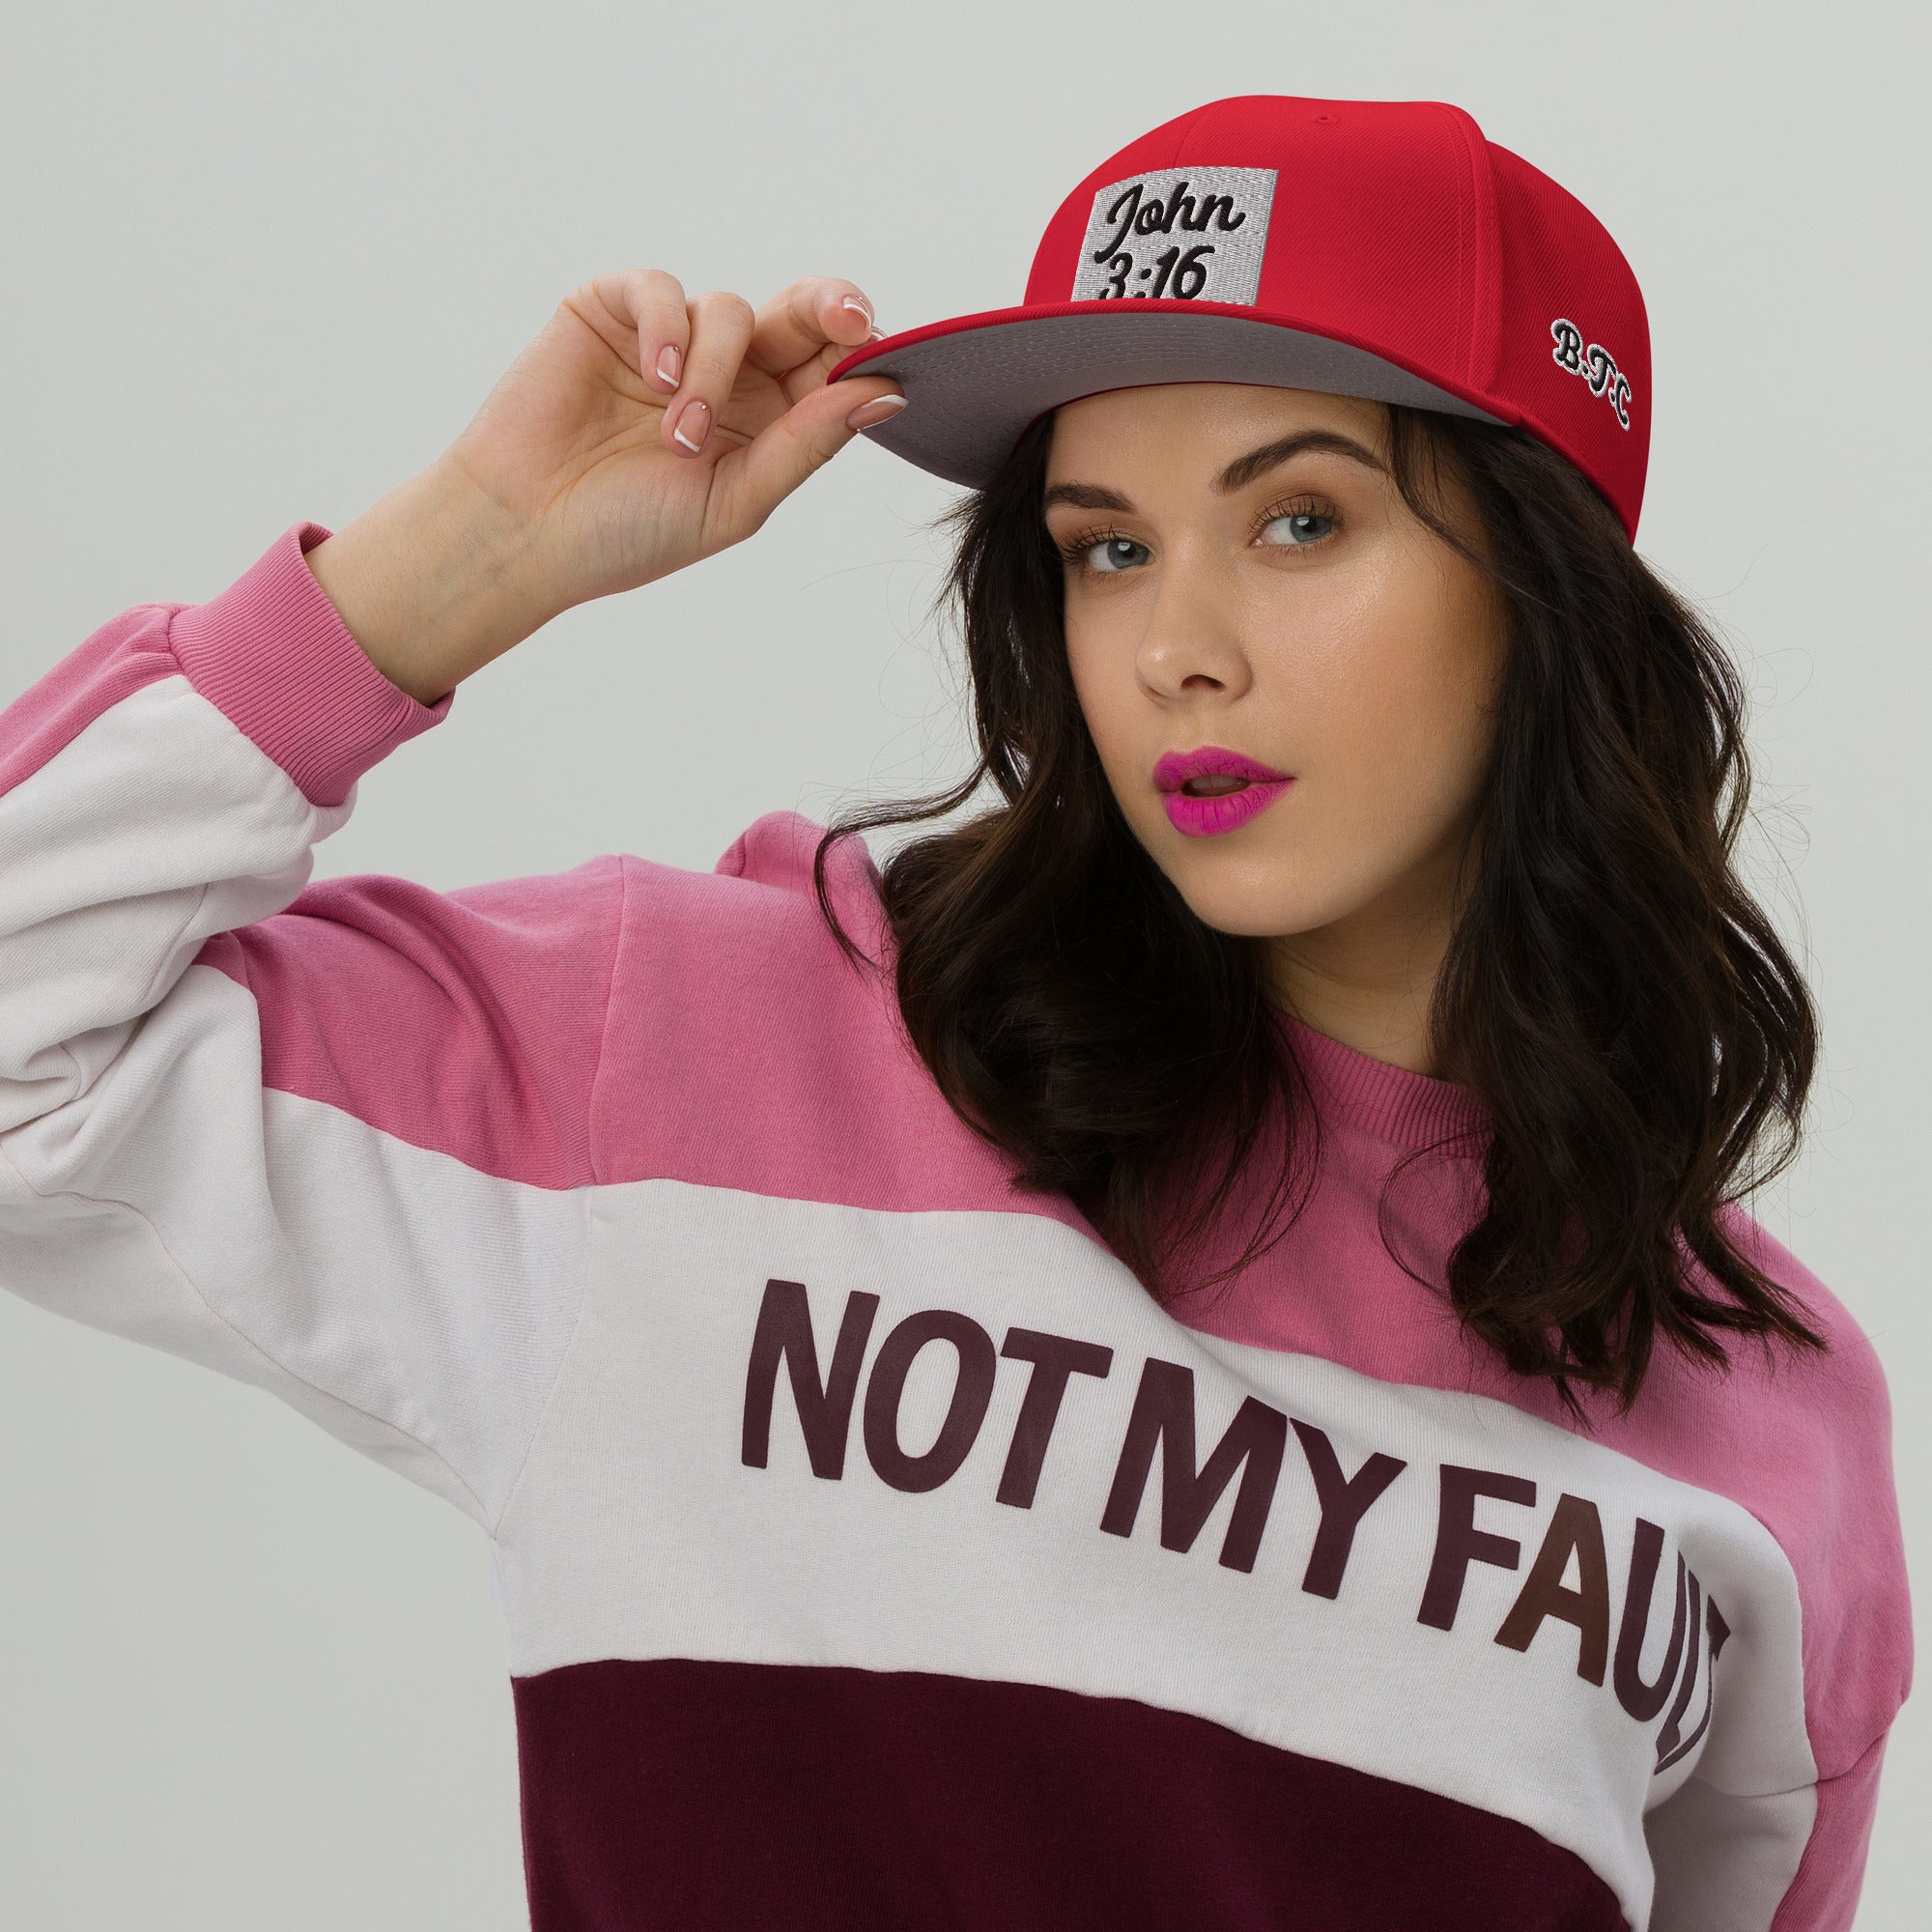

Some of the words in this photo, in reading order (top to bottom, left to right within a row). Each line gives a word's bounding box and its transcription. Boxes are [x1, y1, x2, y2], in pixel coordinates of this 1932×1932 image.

[1094, 182, 1246, 264] John
[1099, 245, 1215, 300] 3:16
[741, 1278, 1114, 1509] NOT
[1099, 1357, 1407, 1600] MY
